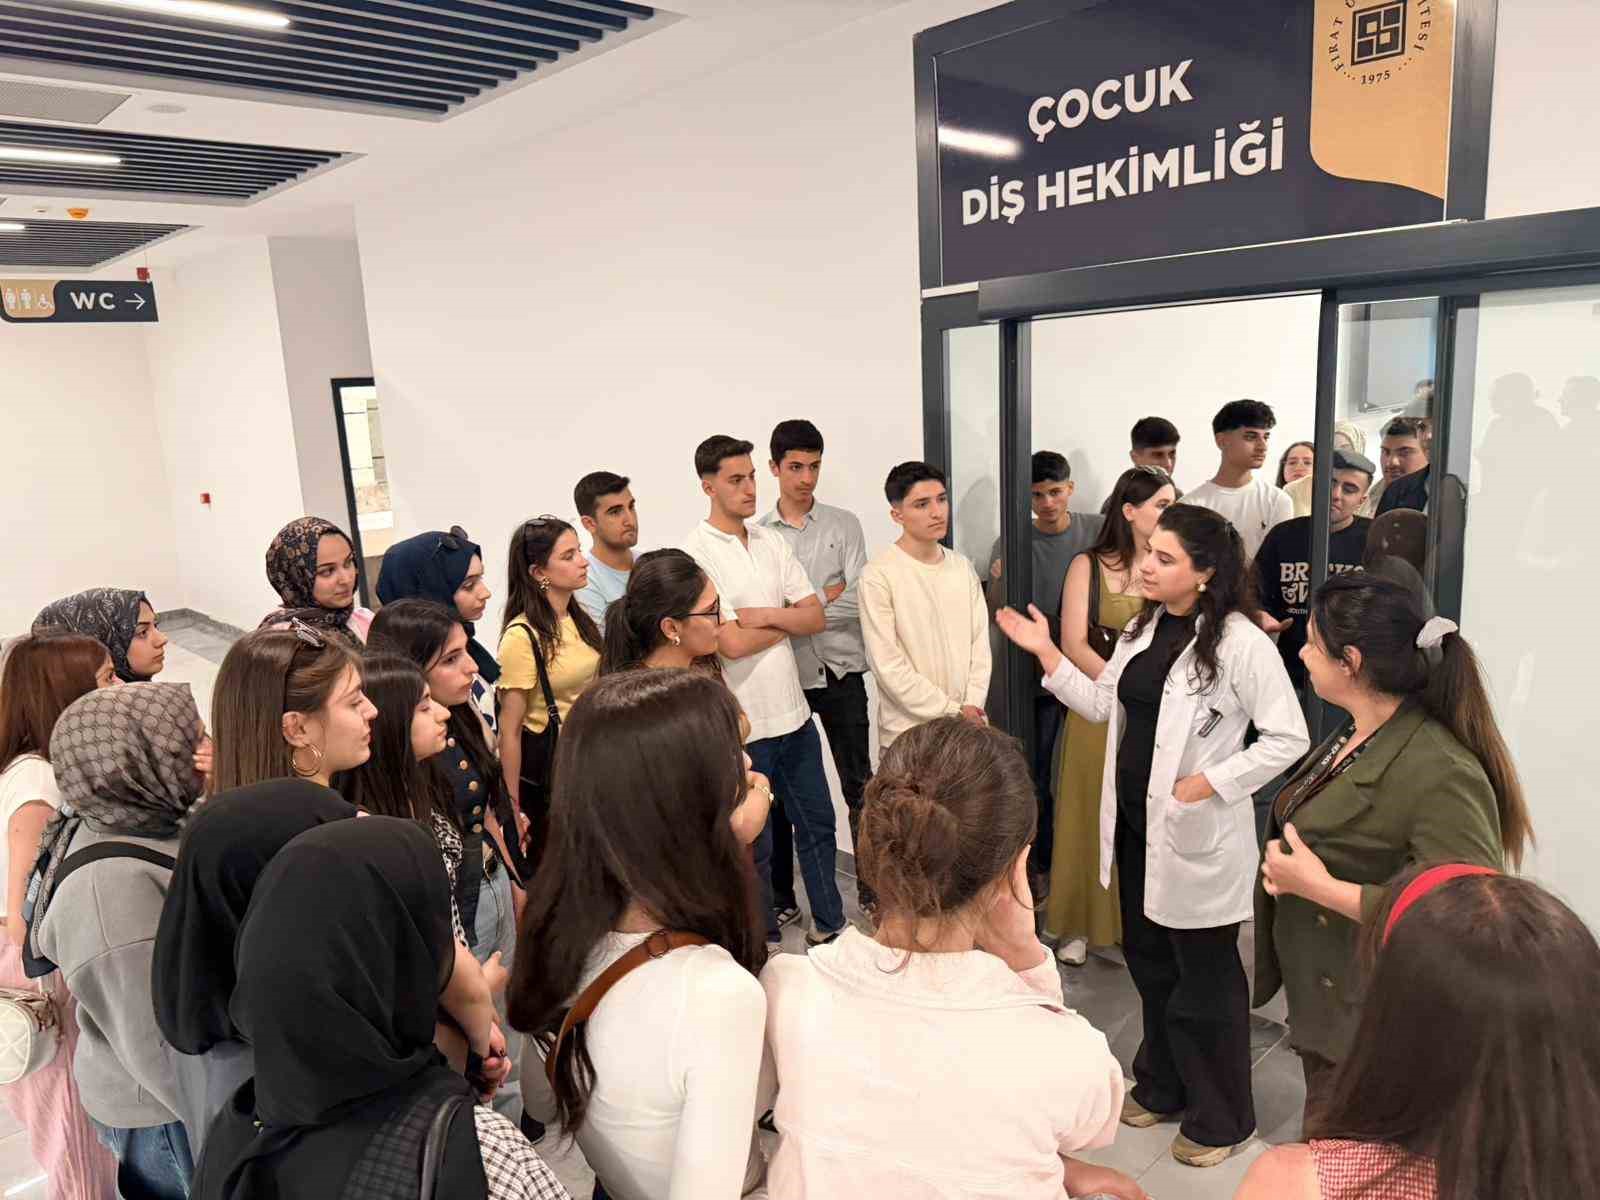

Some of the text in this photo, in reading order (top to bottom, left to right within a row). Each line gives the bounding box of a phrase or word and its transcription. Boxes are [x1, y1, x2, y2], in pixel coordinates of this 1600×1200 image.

[1028, 59, 1193, 142] ÇOCUK
[1361, 70, 1390, 85] 1975
[962, 117, 1284, 225] DİŞ HEKİMLİĞİ
[70, 292, 116, 310] WC
